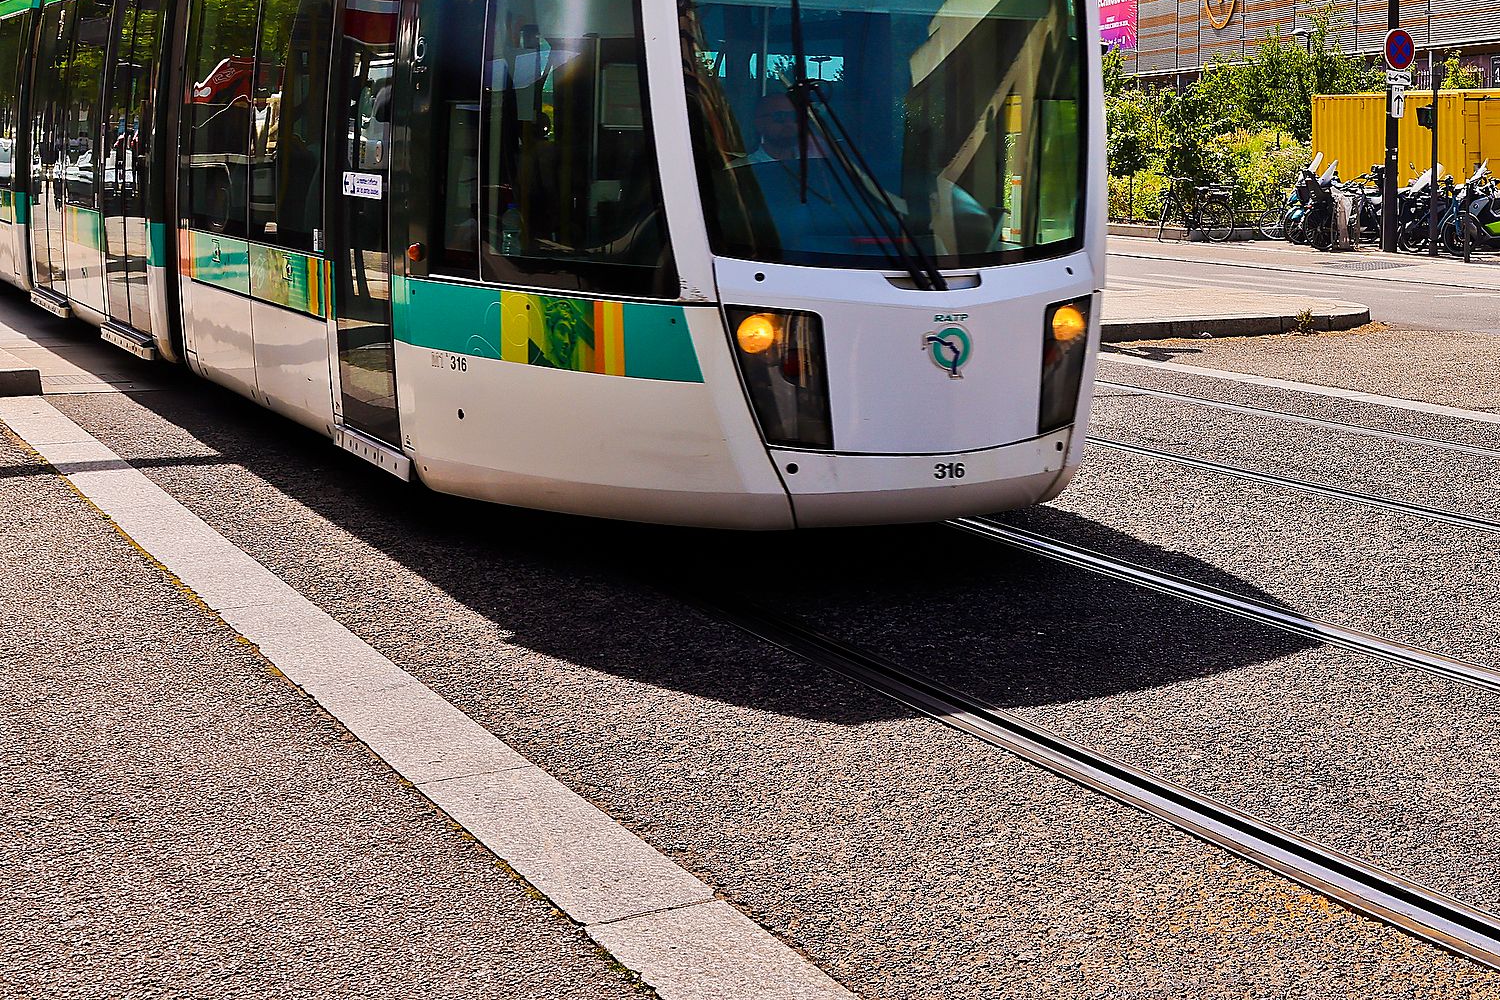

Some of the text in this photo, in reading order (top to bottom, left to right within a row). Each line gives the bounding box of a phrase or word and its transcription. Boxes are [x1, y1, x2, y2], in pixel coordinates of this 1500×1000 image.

[934, 313, 969, 323] RATP
[450, 355, 467, 372] 316
[933, 462, 966, 480] 316
